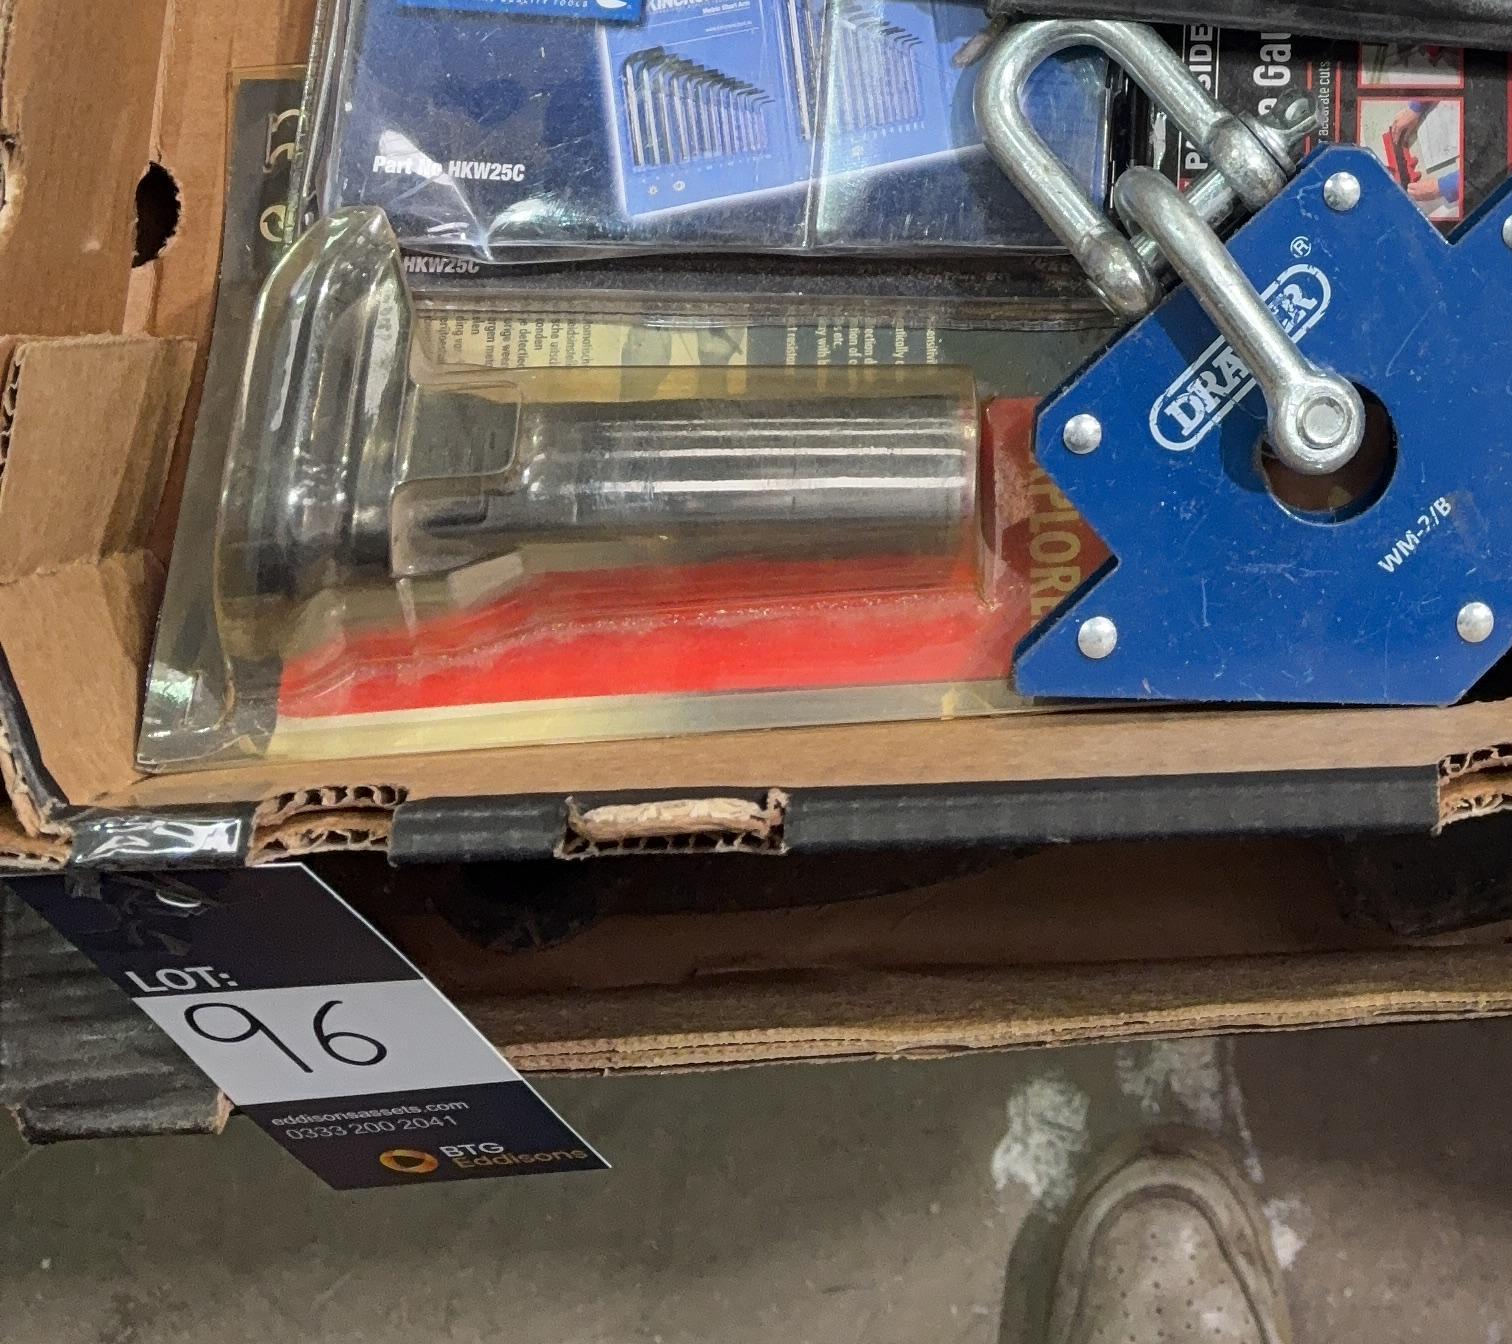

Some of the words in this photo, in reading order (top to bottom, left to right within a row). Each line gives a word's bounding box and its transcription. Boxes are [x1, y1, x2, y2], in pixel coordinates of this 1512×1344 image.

[1183, 22, 1212, 172] PSIDE
[372, 155, 411, 173] Part
[448, 160, 525, 181] HKW25C
[403, 255, 480, 273] HKW25C
[816, 337, 829, 356] with
[833, 332, 842, 348] etc.
[1163, 279, 1318, 443] DRAER
[1029, 467, 1081, 615] PLORE
[124, 966, 239, 994] LOT:
[183, 998, 389, 1075] 96
[271, 1099, 470, 1129] eddisonsassets.com
[285, 1121, 347, 1141] 0333
[351, 1117, 396, 1136] 200
[398, 1113, 458, 1133] 2041
[438, 1142, 505, 1160] BTG
[451, 1145, 588, 1170] Eddisons
